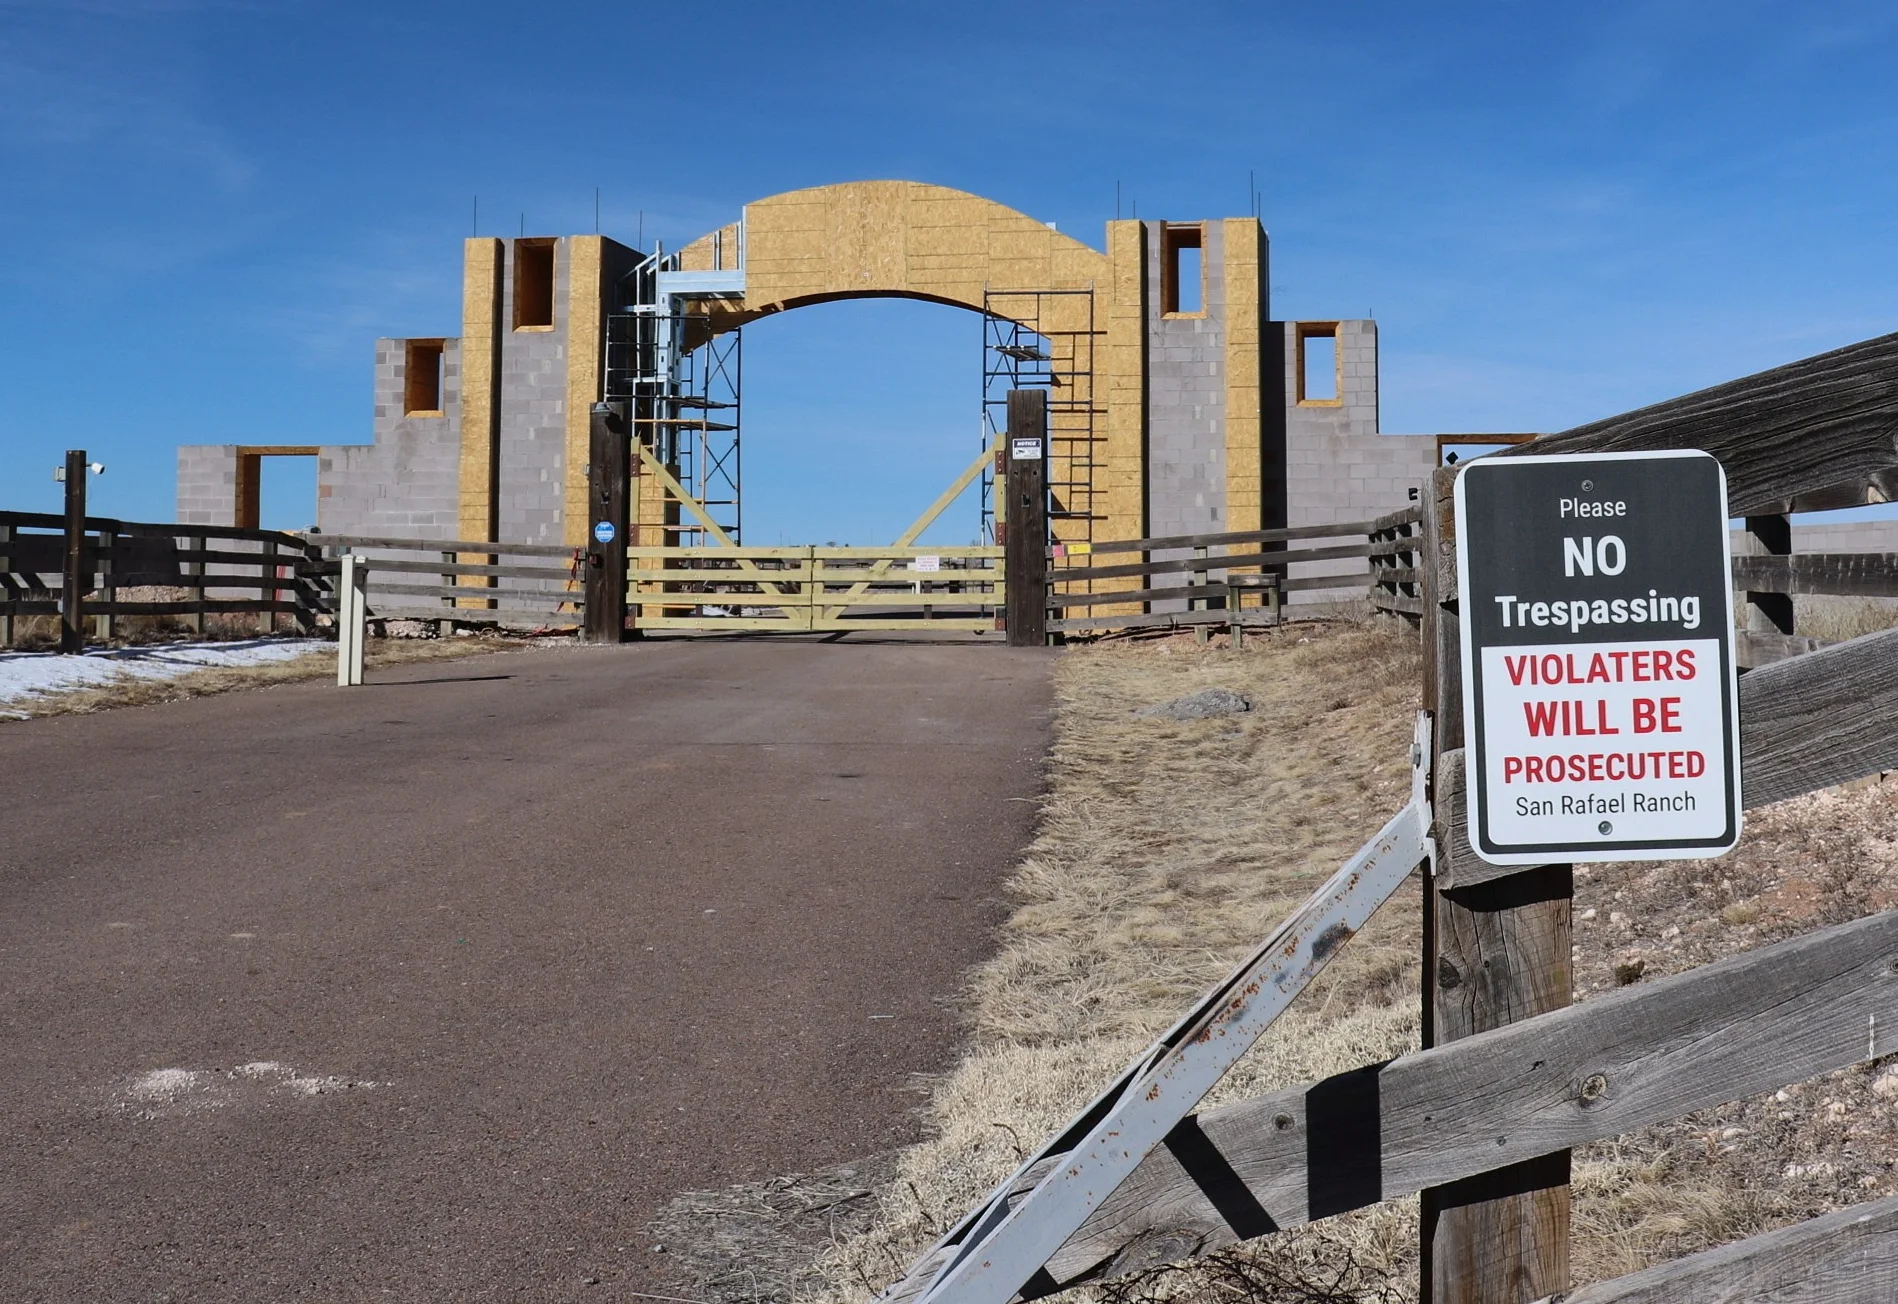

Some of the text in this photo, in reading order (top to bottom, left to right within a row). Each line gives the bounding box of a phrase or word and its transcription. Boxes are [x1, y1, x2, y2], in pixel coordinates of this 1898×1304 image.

[1560, 498, 1627, 518] Please
[1564, 535, 1627, 577] NO
[1495, 590, 1701, 633] Trespassing
[1504, 649, 1697, 686] VIOLATERS
[1523, 697, 1682, 737] WILL BE
[1504, 751, 1706, 784] PROSECUTED
[1516, 791, 1697, 816] San Rafael Ranch
